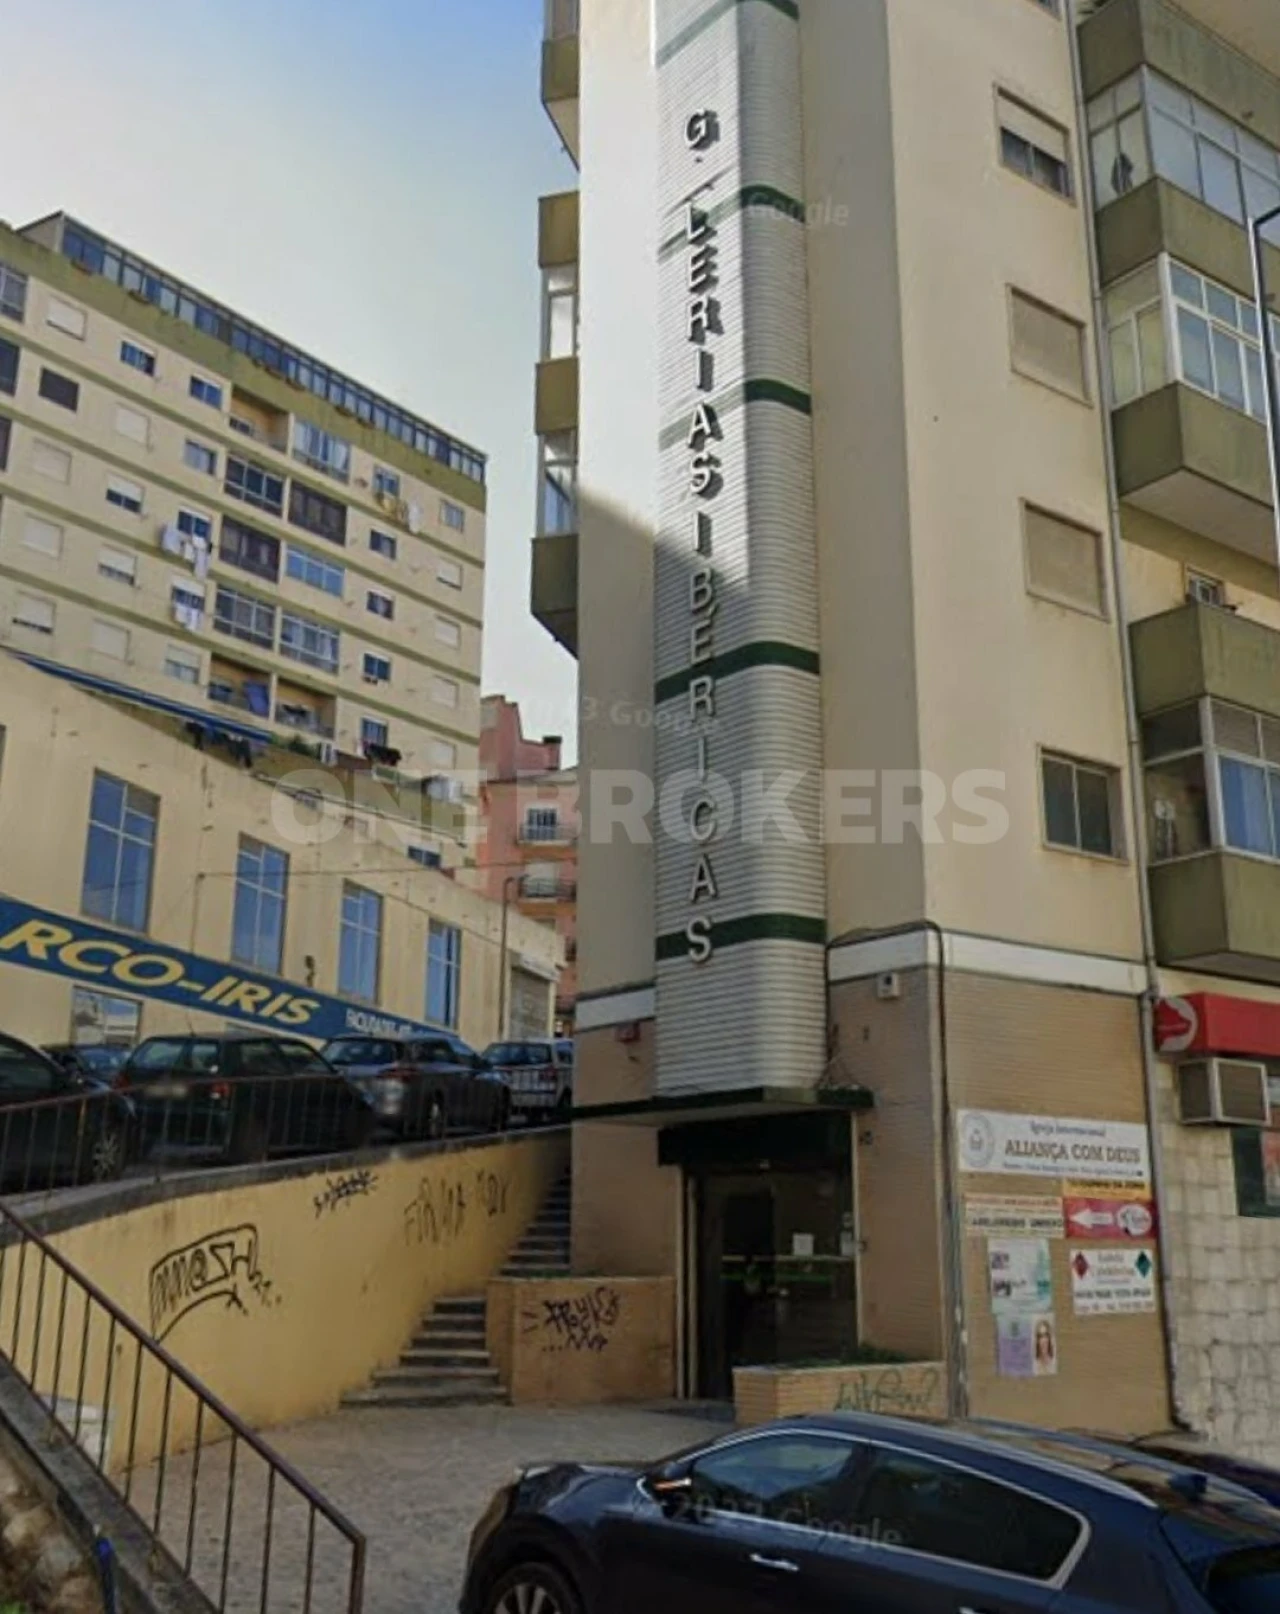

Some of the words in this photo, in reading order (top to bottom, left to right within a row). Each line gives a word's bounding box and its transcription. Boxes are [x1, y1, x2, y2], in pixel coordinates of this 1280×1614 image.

[685, 108, 722, 497] GLERIAS
[1071, 1144, 1102, 1160] COM
[1106, 1147, 1140, 1163] DEUS
